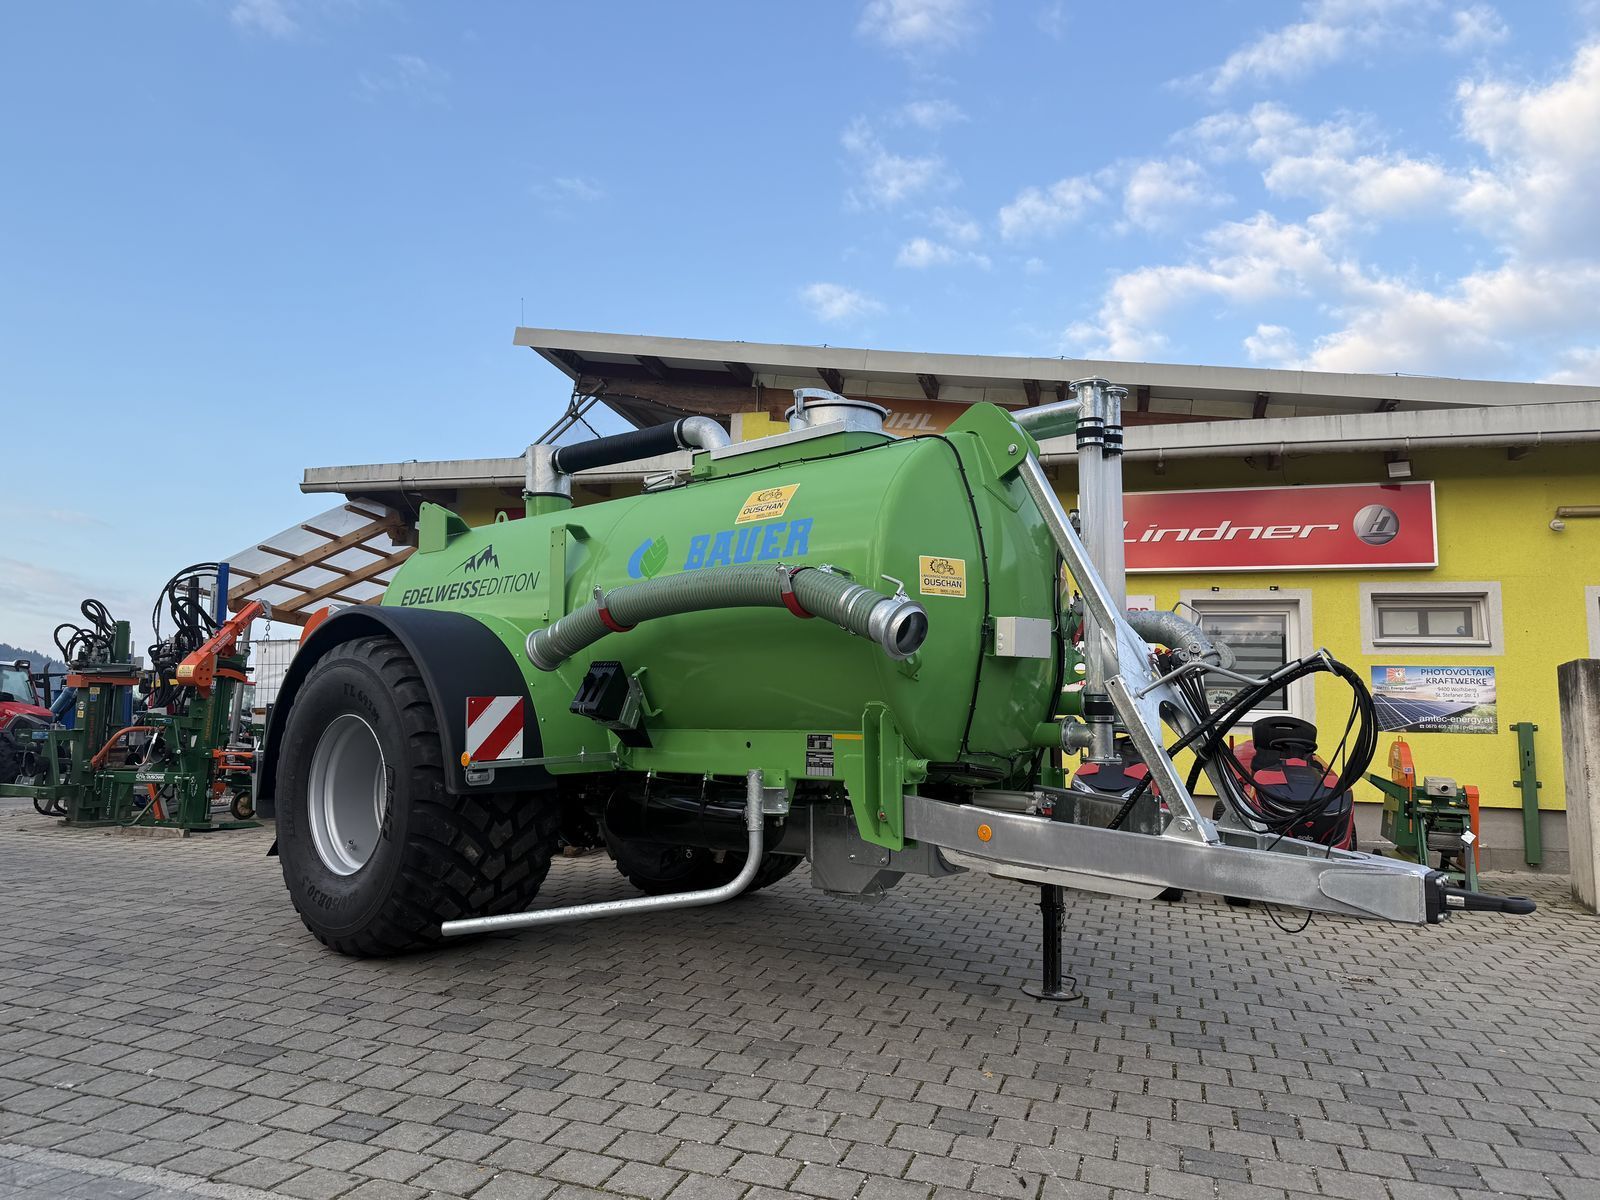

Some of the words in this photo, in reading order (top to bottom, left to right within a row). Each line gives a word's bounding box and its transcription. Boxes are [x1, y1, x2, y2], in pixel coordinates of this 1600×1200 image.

[887, 412, 937, 430] IHL
[743, 502, 785, 515] OUSCHAN
[683, 517, 814, 571] BAUER
[400, 571, 540, 606] EDELWEISSEDITION
[924, 578, 962, 588] OUSCHAN
[1420, 668, 1492, 676] PHOTOVOLTAIK
[1425, 677, 1487, 685] KRAFTWERKE
[1419, 715, 1493, 724] amtec-energy.at
